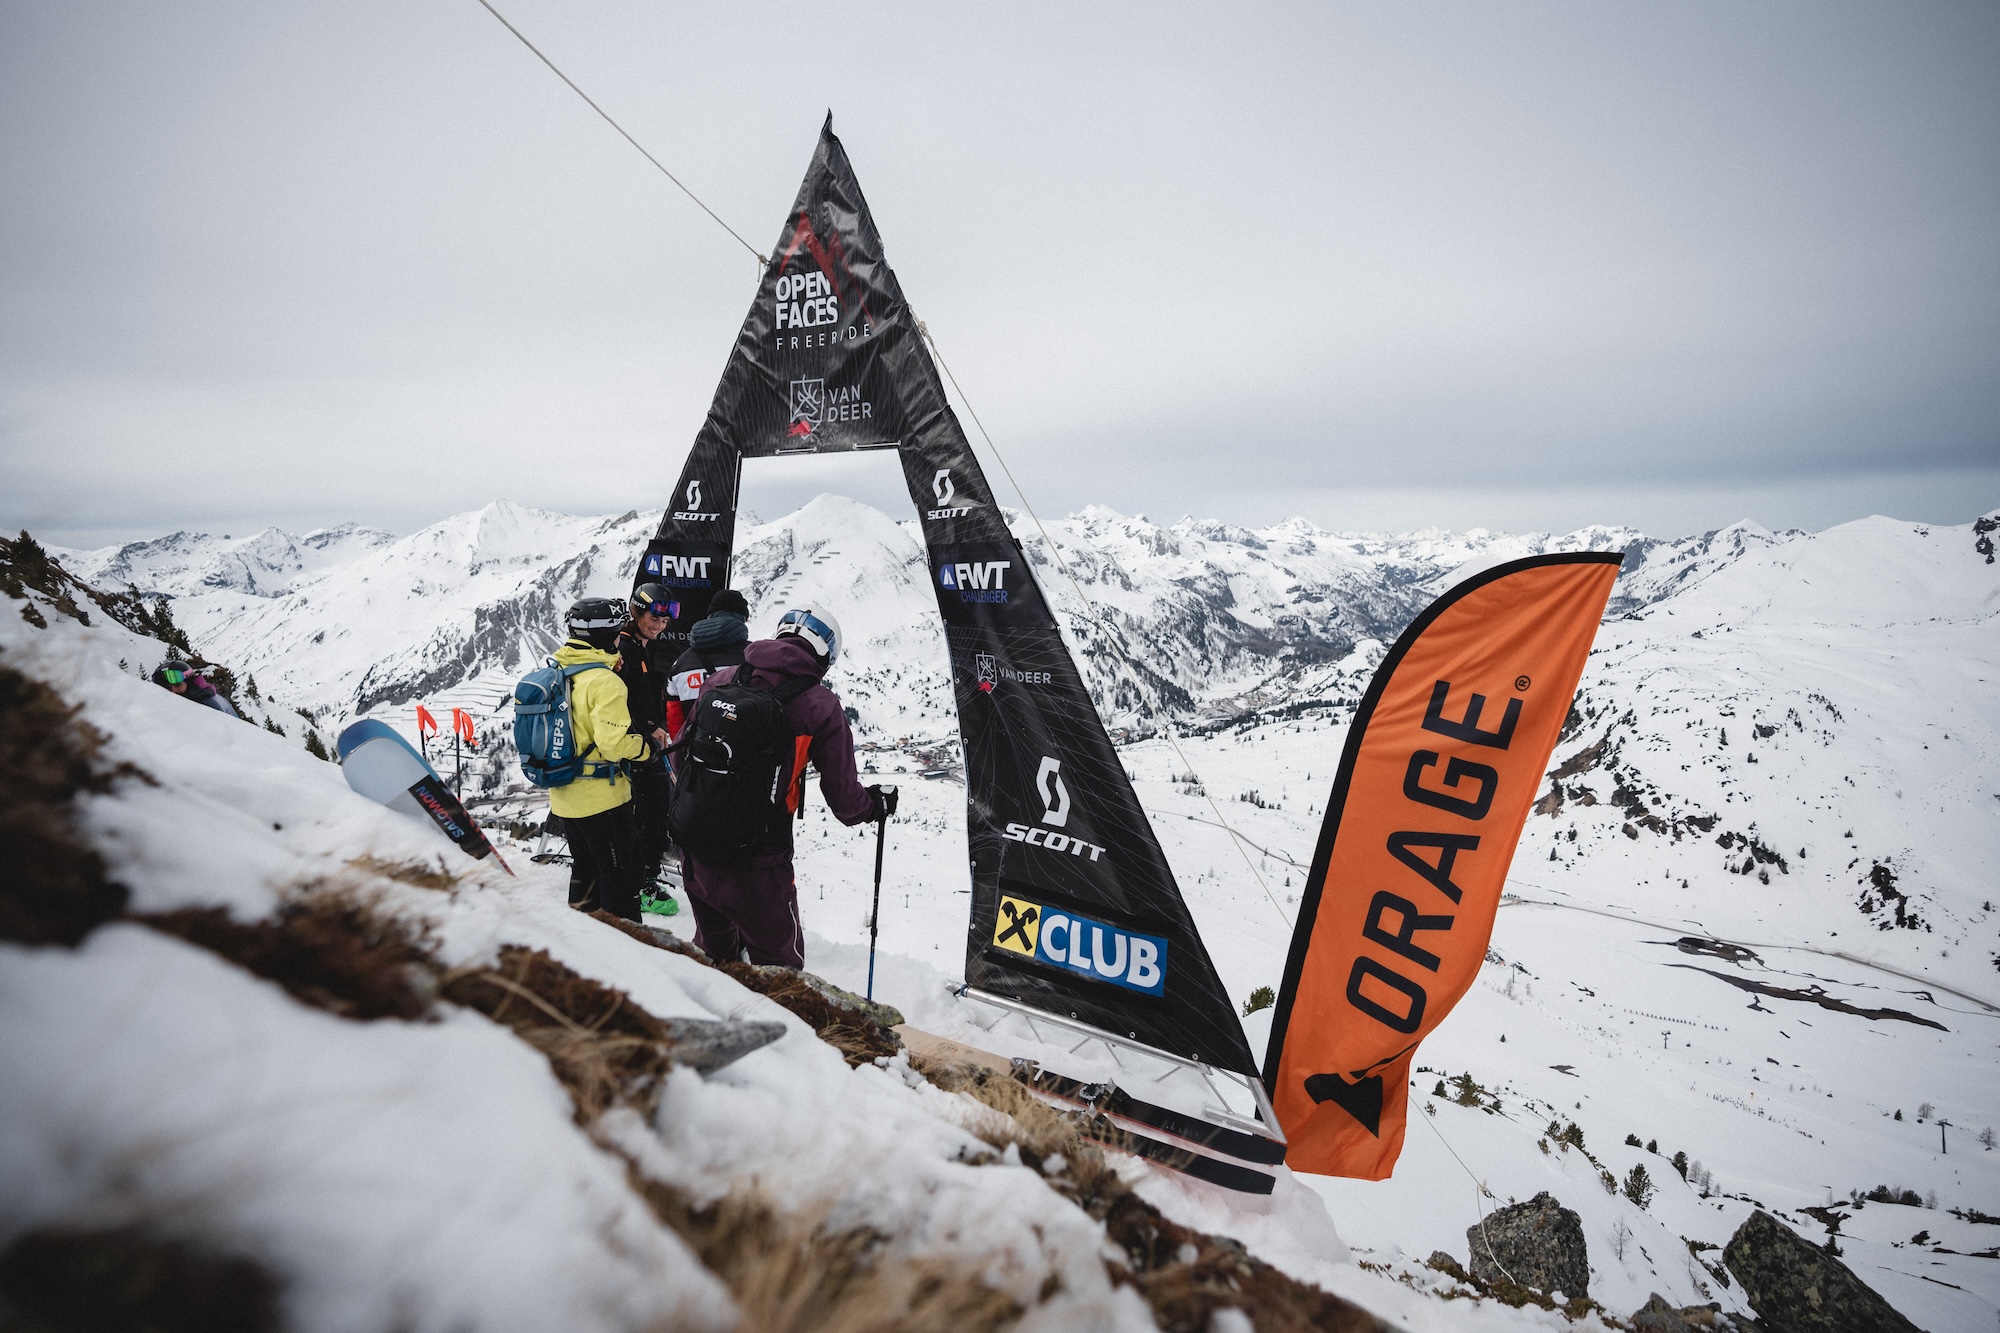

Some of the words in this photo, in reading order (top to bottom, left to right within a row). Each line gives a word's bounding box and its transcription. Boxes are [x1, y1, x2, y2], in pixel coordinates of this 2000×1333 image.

[775, 271, 831, 302] OPEN
[775, 296, 838, 330] FACES
[828, 384, 861, 404] VAN
[827, 402, 872, 423] DEER
[672, 511, 720, 521] SCOTT
[927, 506, 973, 520] SCOTT
[661, 555, 711, 579] FWT
[955, 561, 1011, 590] FWT
[661, 577, 711, 589] CHALLENGER
[961, 590, 1008, 603] CHALLENGER
[654, 632, 676, 641] AN
[1000, 667, 1017, 681] VAN
[1016, 671, 1051, 684] DEER
[551, 718, 565, 760] PIEPS
[415, 785, 465, 838] SALOMON
[1001, 822, 1107, 862] SCOTT
[1041, 914, 1161, 988] CLUB
